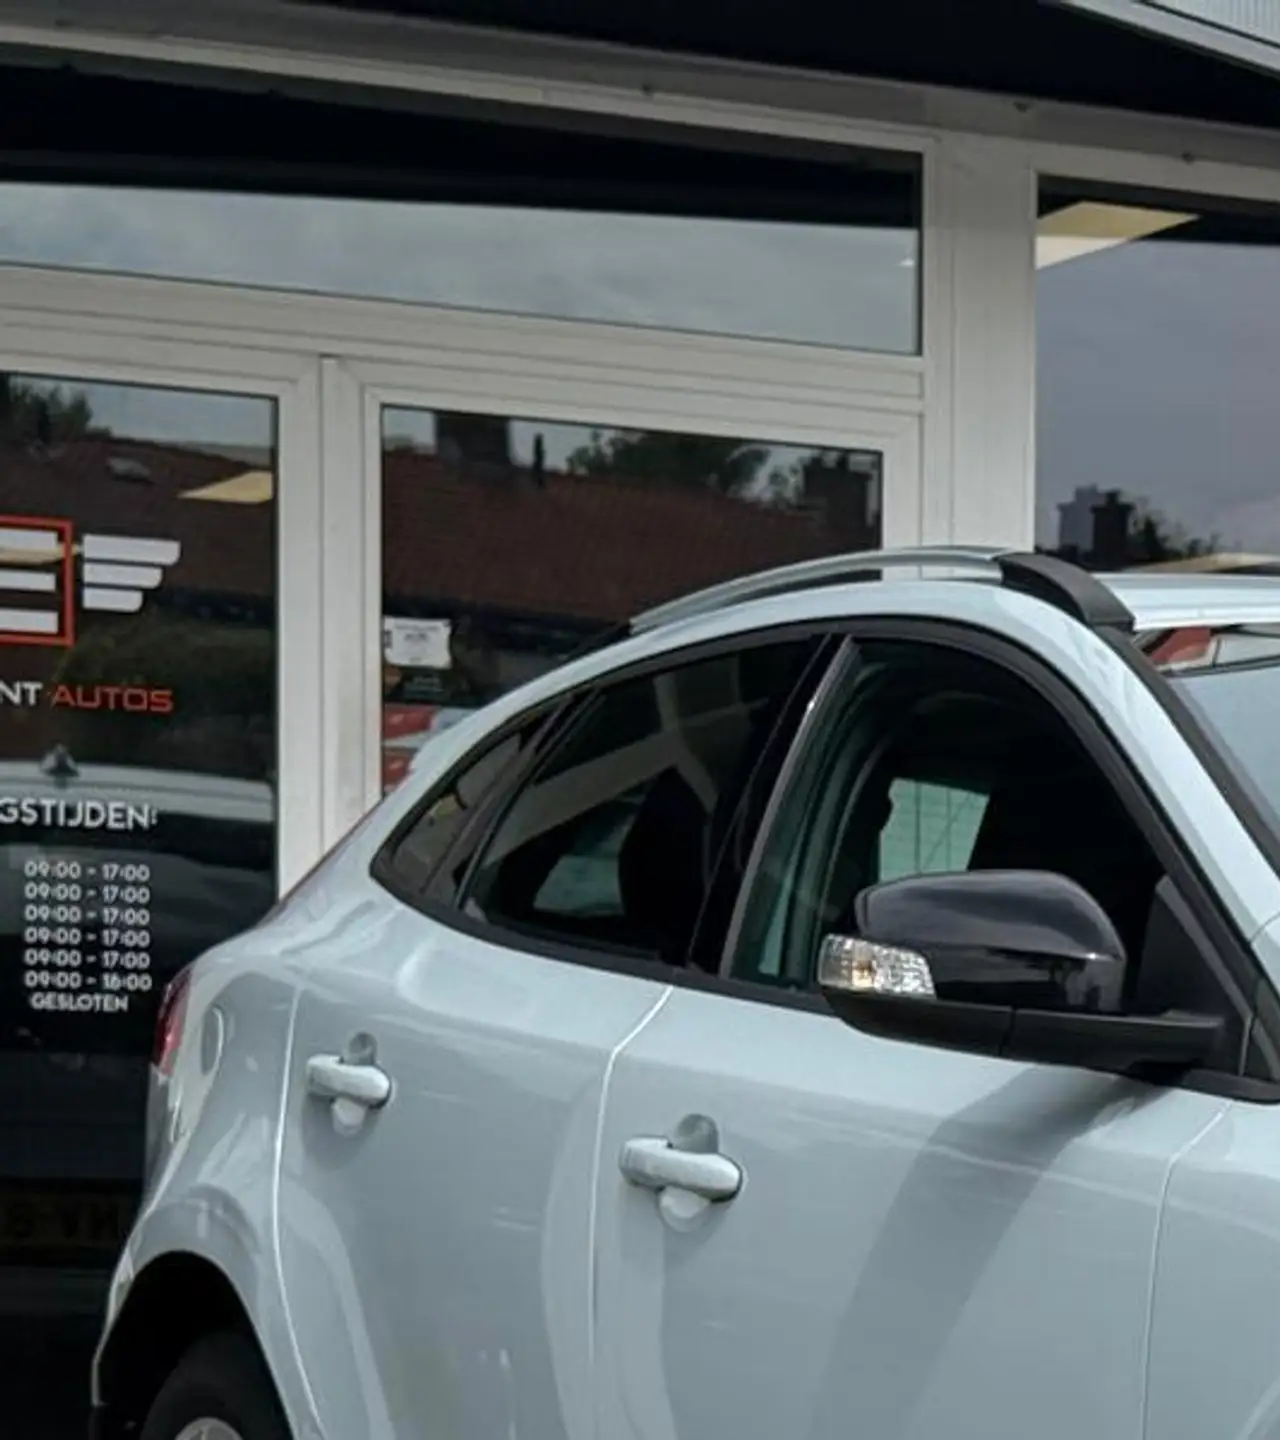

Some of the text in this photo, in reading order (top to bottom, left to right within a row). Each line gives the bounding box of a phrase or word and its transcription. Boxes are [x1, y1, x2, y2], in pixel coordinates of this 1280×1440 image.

[52, 684, 174, 713] AUTOS
[24, 860, 82, 879] 09:00
[102, 864, 150, 882] 17:00
[24, 881, 82, 900] 09:00
[102, 884, 150, 903] 17:00
[24, 904, 82, 923] 09:00
[102, 907, 150, 926] 17:00
[24, 926, 82, 945] 09:00
[102, 928, 150, 948] 17:00
[24, 948, 82, 967] 09:00
[102, 950, 150, 970] 17:00
[24, 970, 82, 989] 09:00
[30, 991, 129, 1013] GESLOTEN
